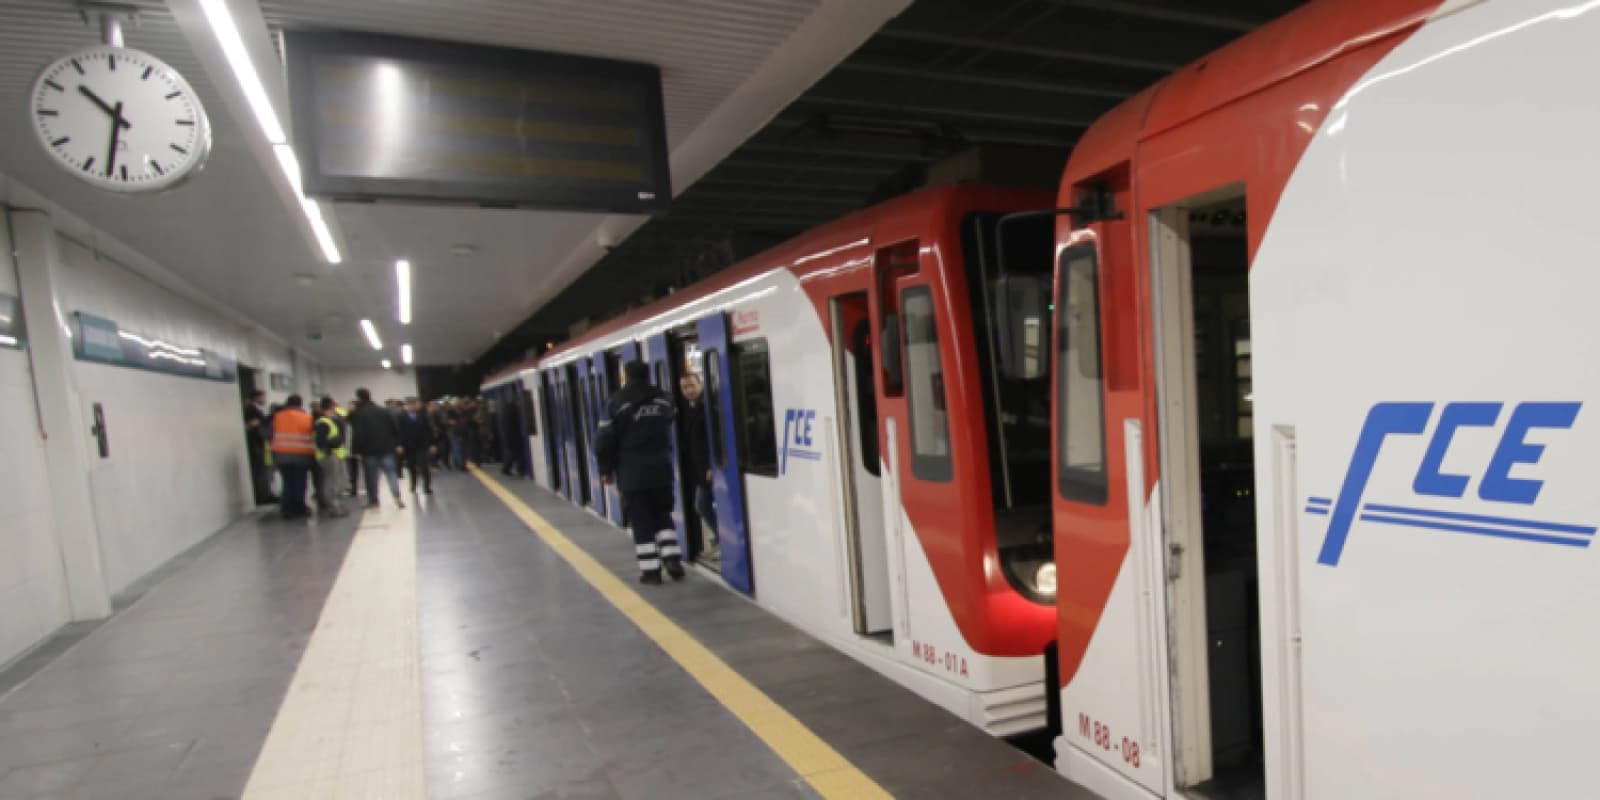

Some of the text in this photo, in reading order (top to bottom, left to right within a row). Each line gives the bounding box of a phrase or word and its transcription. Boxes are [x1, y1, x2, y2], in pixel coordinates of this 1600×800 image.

[1316, 400, 1583, 568] FCE
[912, 639, 922, 658] M
[1079, 711, 1091, 740] M
[1094, 720, 1110, 752] 88
